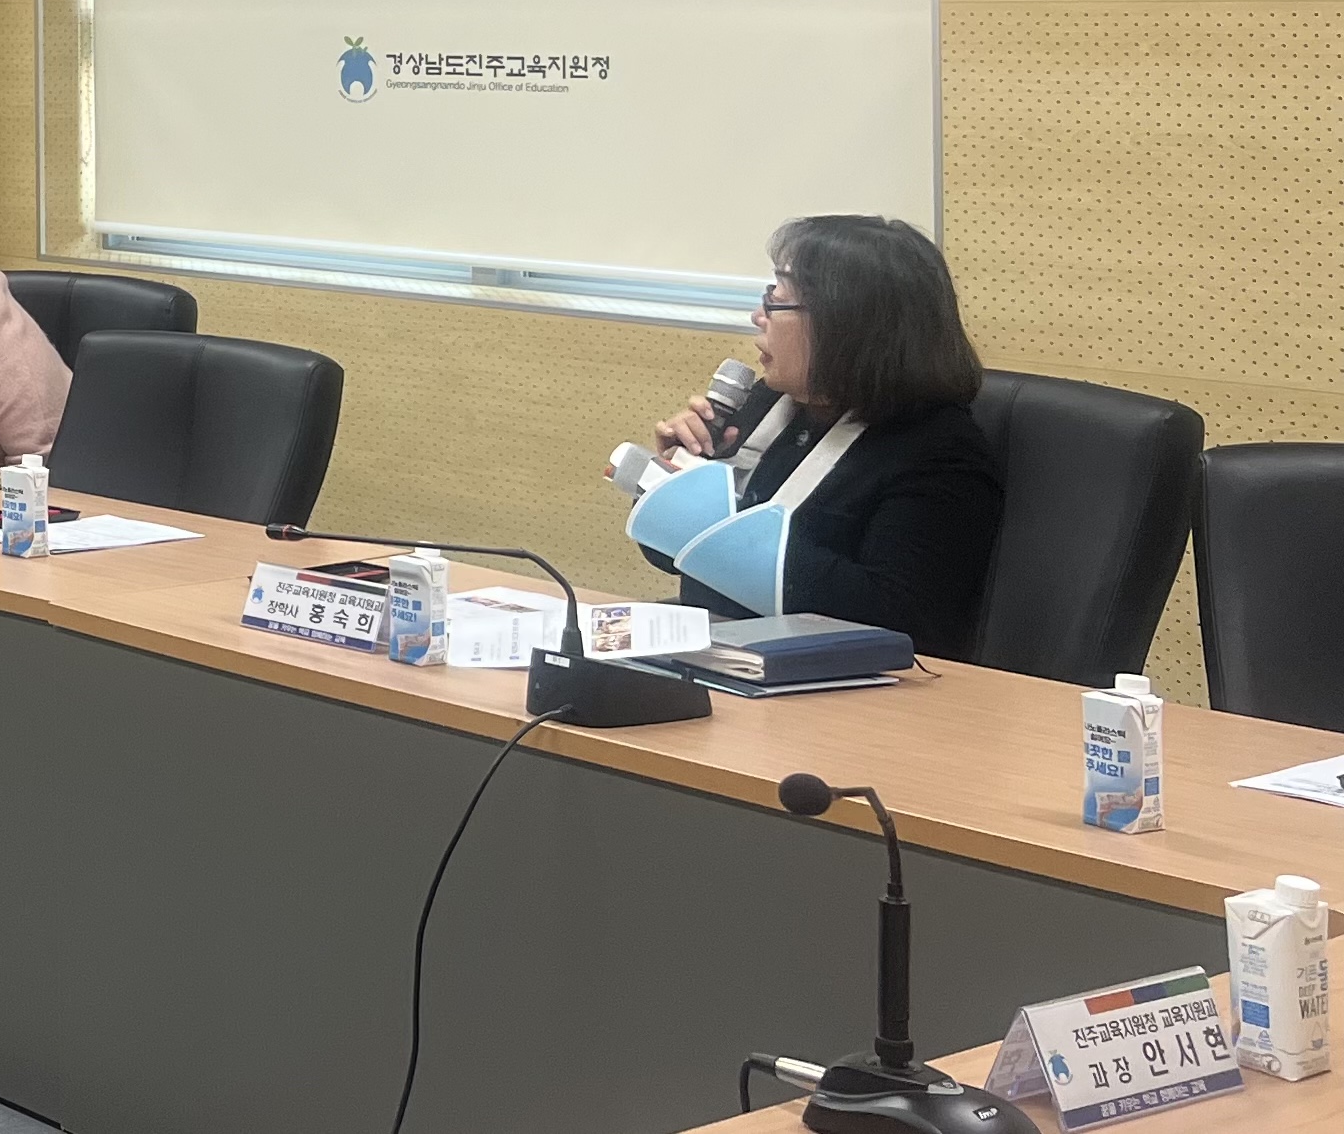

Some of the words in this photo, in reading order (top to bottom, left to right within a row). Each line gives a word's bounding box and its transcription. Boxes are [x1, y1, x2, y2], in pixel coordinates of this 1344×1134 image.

[489, 82, 513, 92] Office
[515, 83, 523, 92] of
[525, 83, 569, 93] Education
[276, 581, 336, 604] 진주교육지원청
[267, 600, 299, 618] 장학사
[1072, 1012, 1159, 1050] 진주교육지원청
[1158, 998, 1219, 1029] 교육지원과
